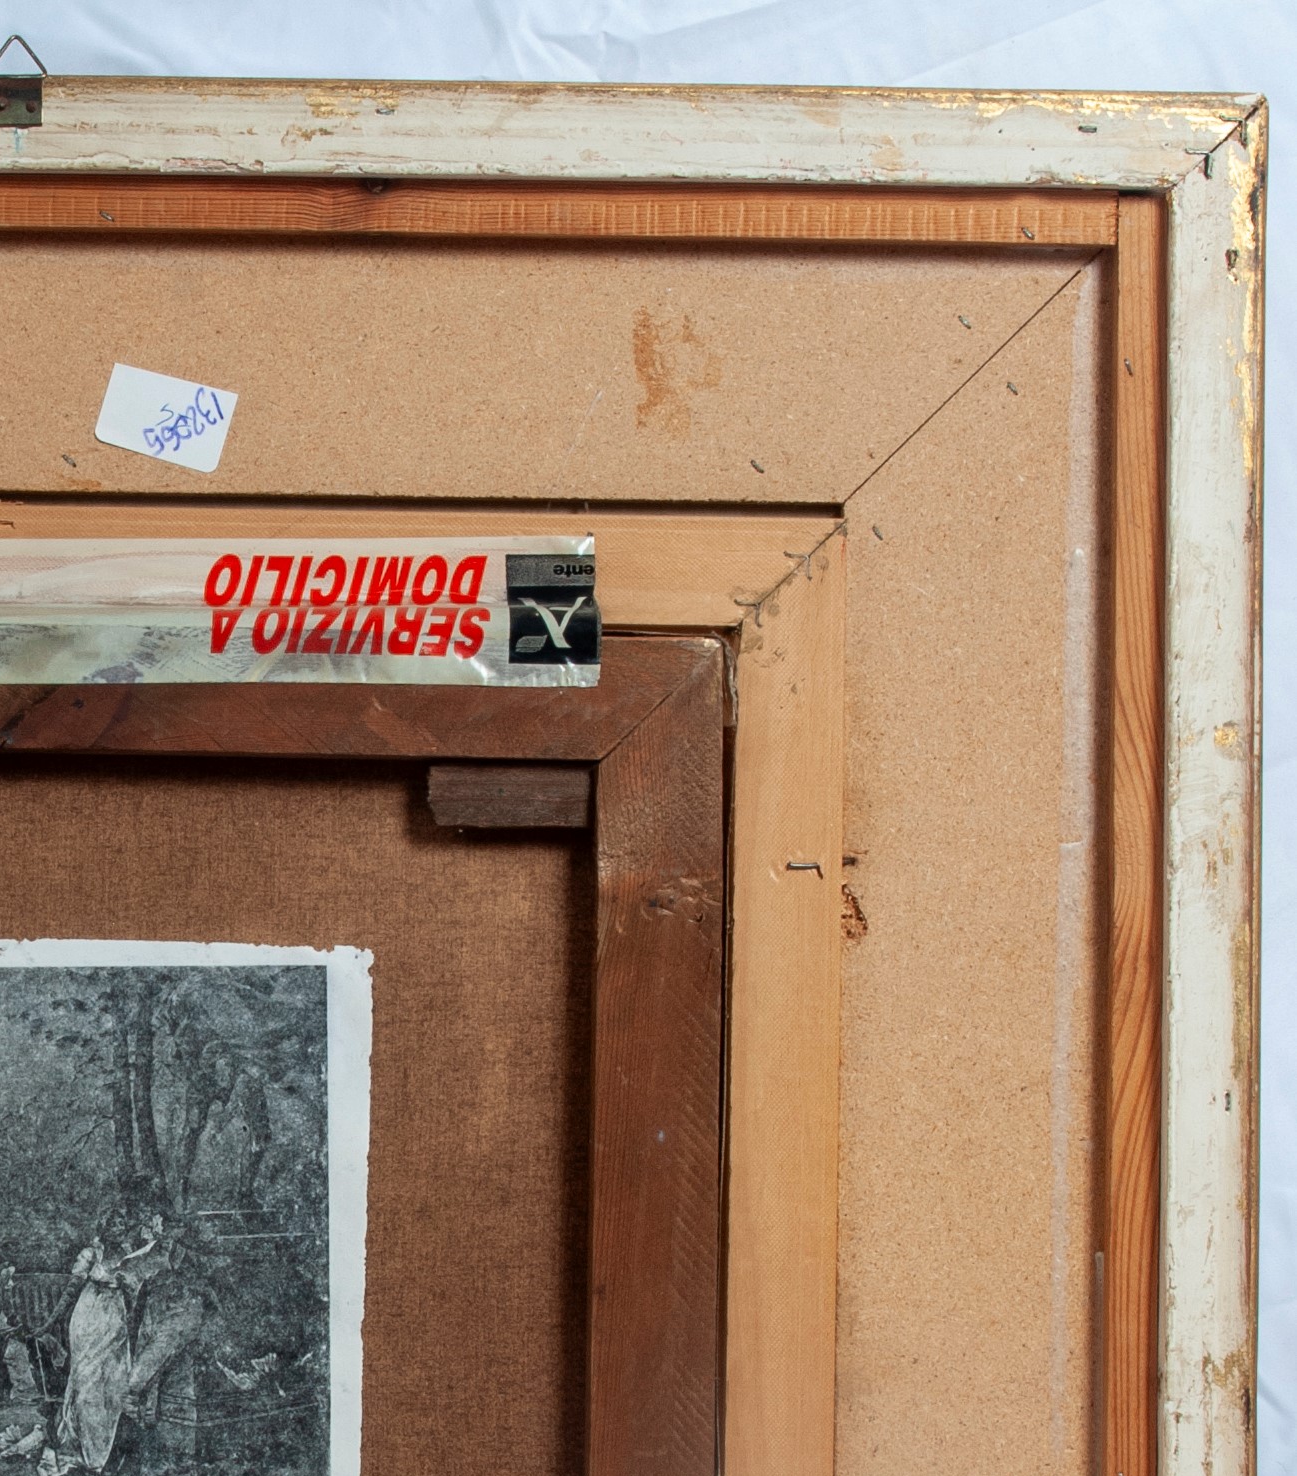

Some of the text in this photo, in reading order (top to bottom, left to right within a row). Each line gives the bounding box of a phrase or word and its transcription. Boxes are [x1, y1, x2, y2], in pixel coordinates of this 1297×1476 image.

[203, 553, 489, 608] DOMICILIO
[209, 606, 492, 660] SERVIZIO A
